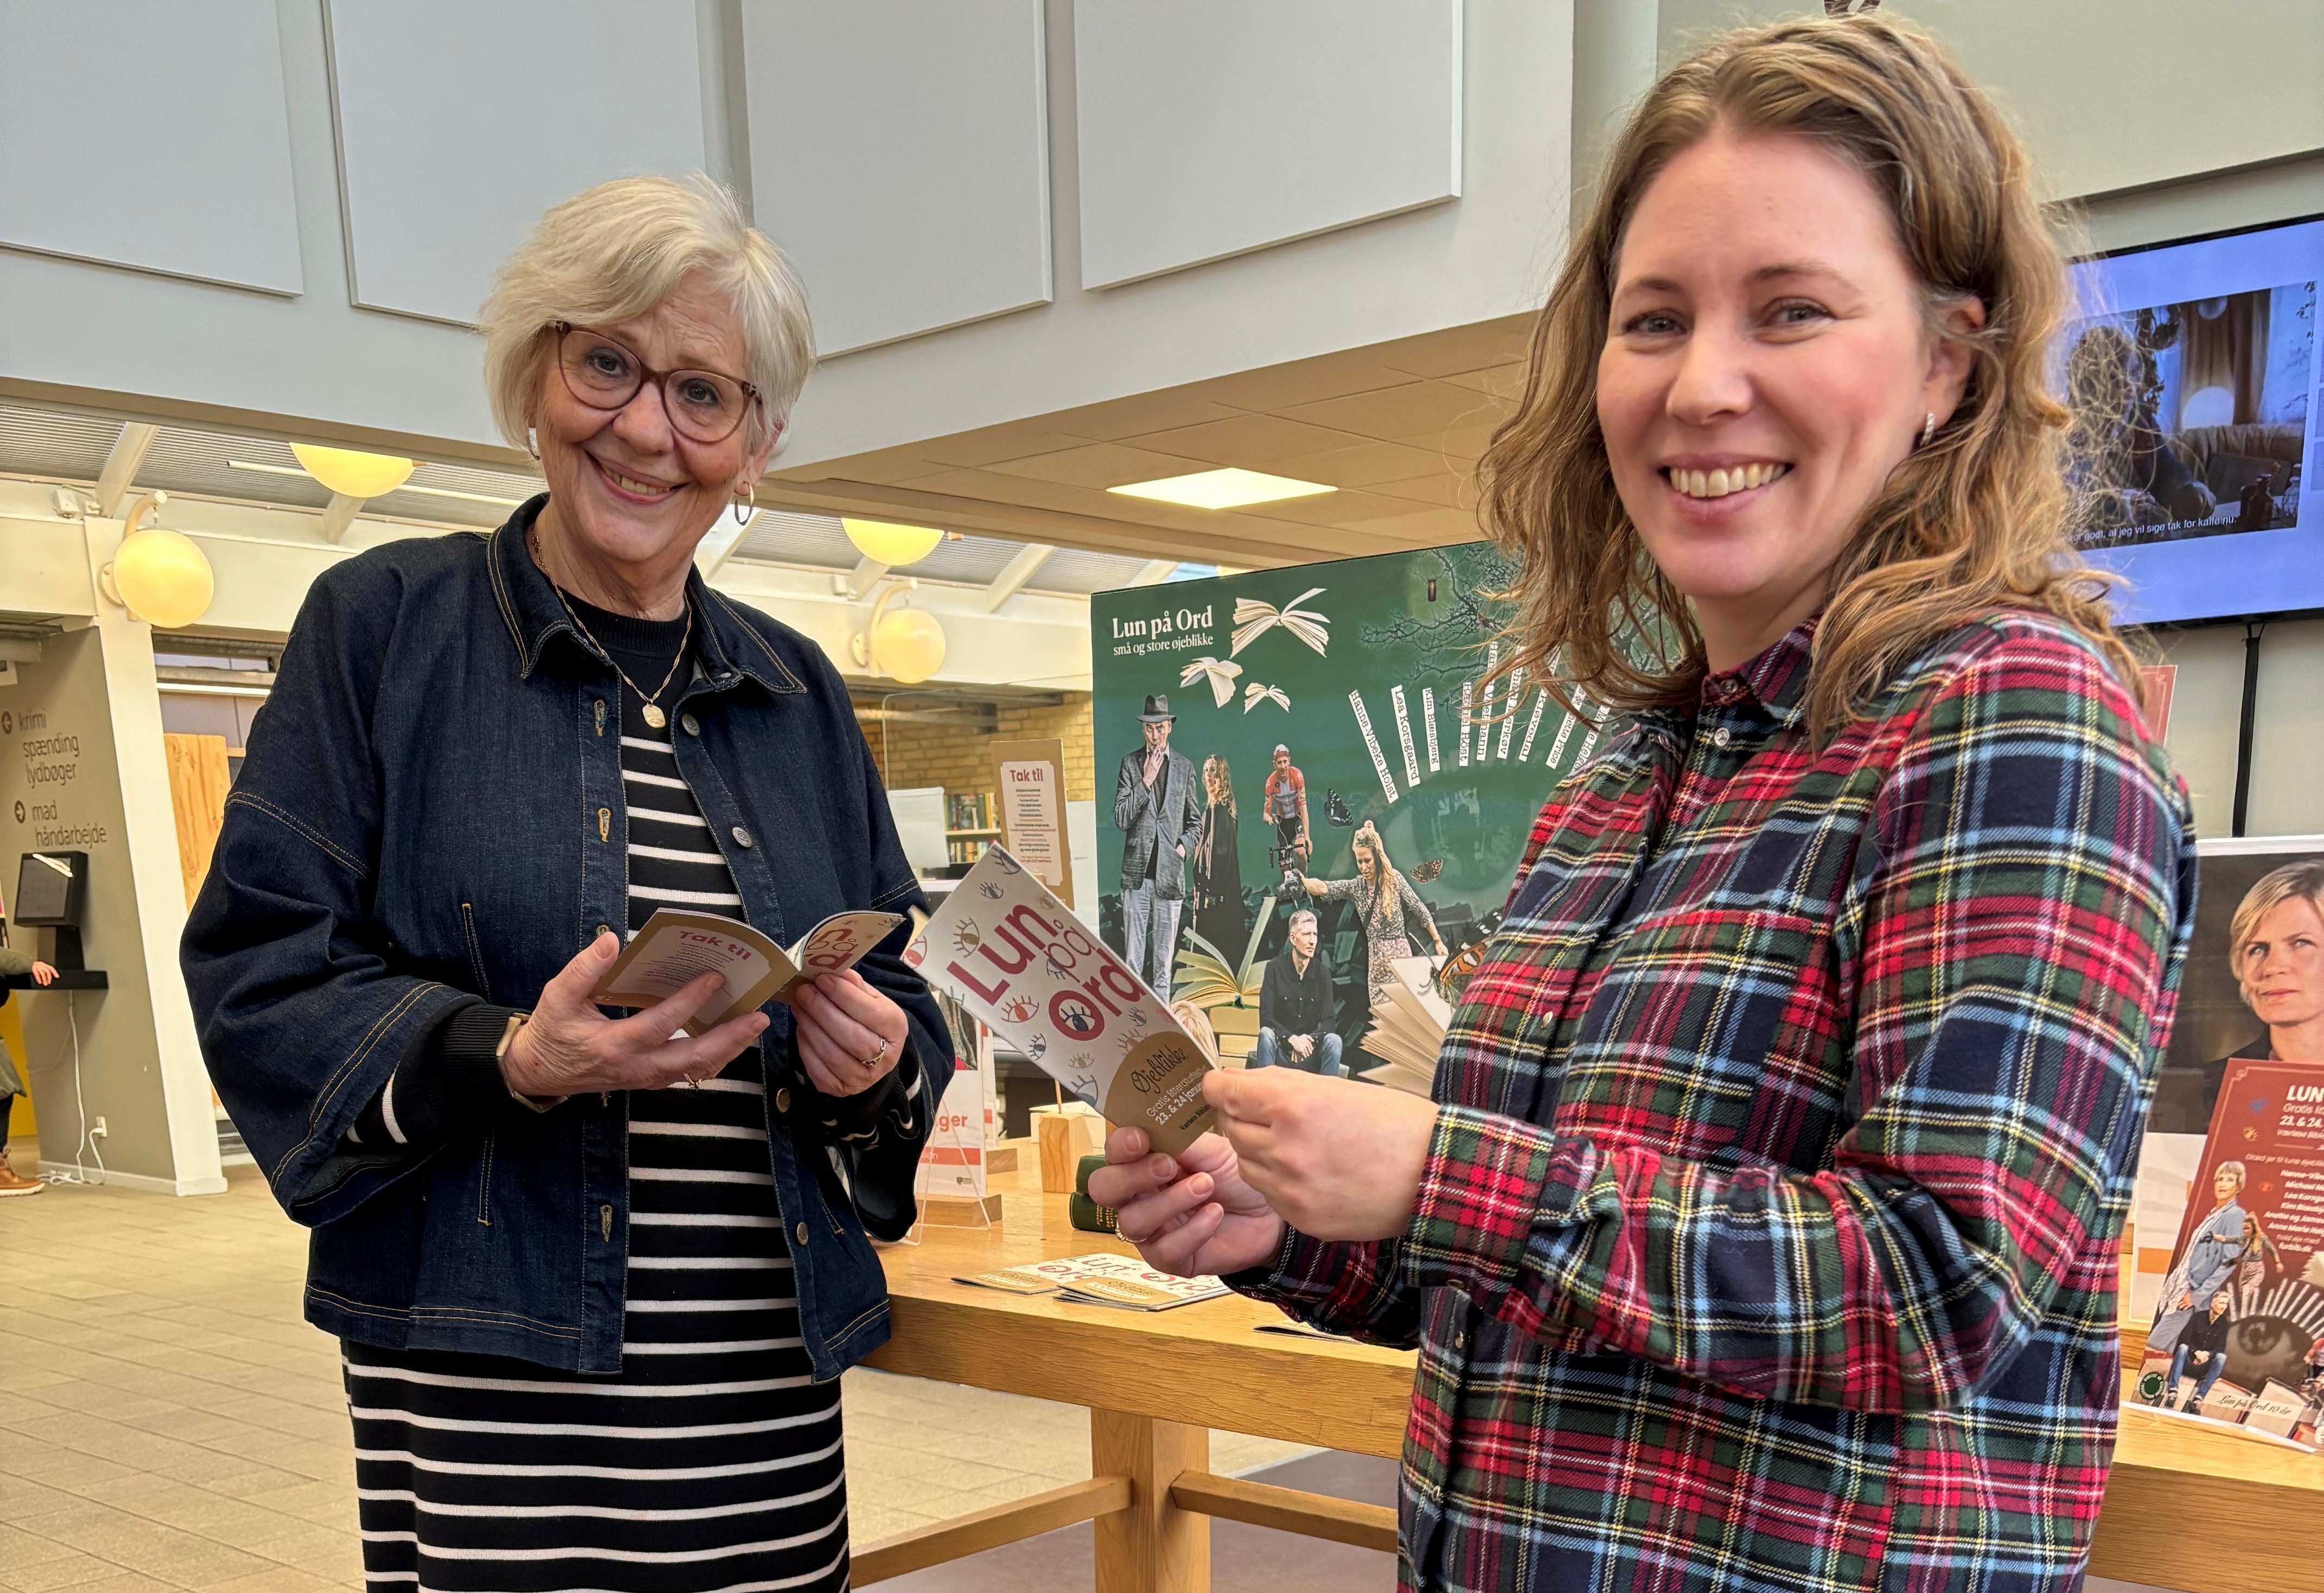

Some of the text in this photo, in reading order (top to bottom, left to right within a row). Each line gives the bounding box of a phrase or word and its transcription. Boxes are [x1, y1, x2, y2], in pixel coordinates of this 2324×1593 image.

[2118, 527, 2133, 538] jeg
[2135, 524, 2144, 534] vil
[2147, 523, 2166, 534] sige
[2167, 520, 2181, 531] tak
[2183, 519, 2197, 529] for
[1112, 605, 1213, 640] Lun på Ord
[1113, 632, 1214, 656] små og store øjeblikke
[18, 707, 47, 732] krimi
[1425, 688, 1439, 764] Kim Blæsbjerg
[23, 732, 80, 762] spænding
[1351, 691, 1396, 798] Hanne-Vibeke Holst
[1395, 689, 1419, 780] Lea Korsgaard
[1460, 732, 1469, 762] Röst
[1550, 740, 1565, 764] Price
[25, 762, 76, 789] lydbøger
[1010, 768, 1044, 782] Tak til
[32, 799, 58, 821] mad
[35, 823, 107, 849] håndarbejde
[680, 931, 752, 961] Tak til
[946, 904, 1147, 1041] Lun på Ord
[1131, 1045, 1191, 1095] Øjeblikke
[1146, 1094, 1172, 1117] Gratis
[2286, 1085, 2324, 1103] LUN
[939, 1115, 968, 1133] ger
[1155, 1112, 1172, 1125] 23.
[1168, 1104, 1179, 1114] &
[2296, 1116, 2306, 1127] &
